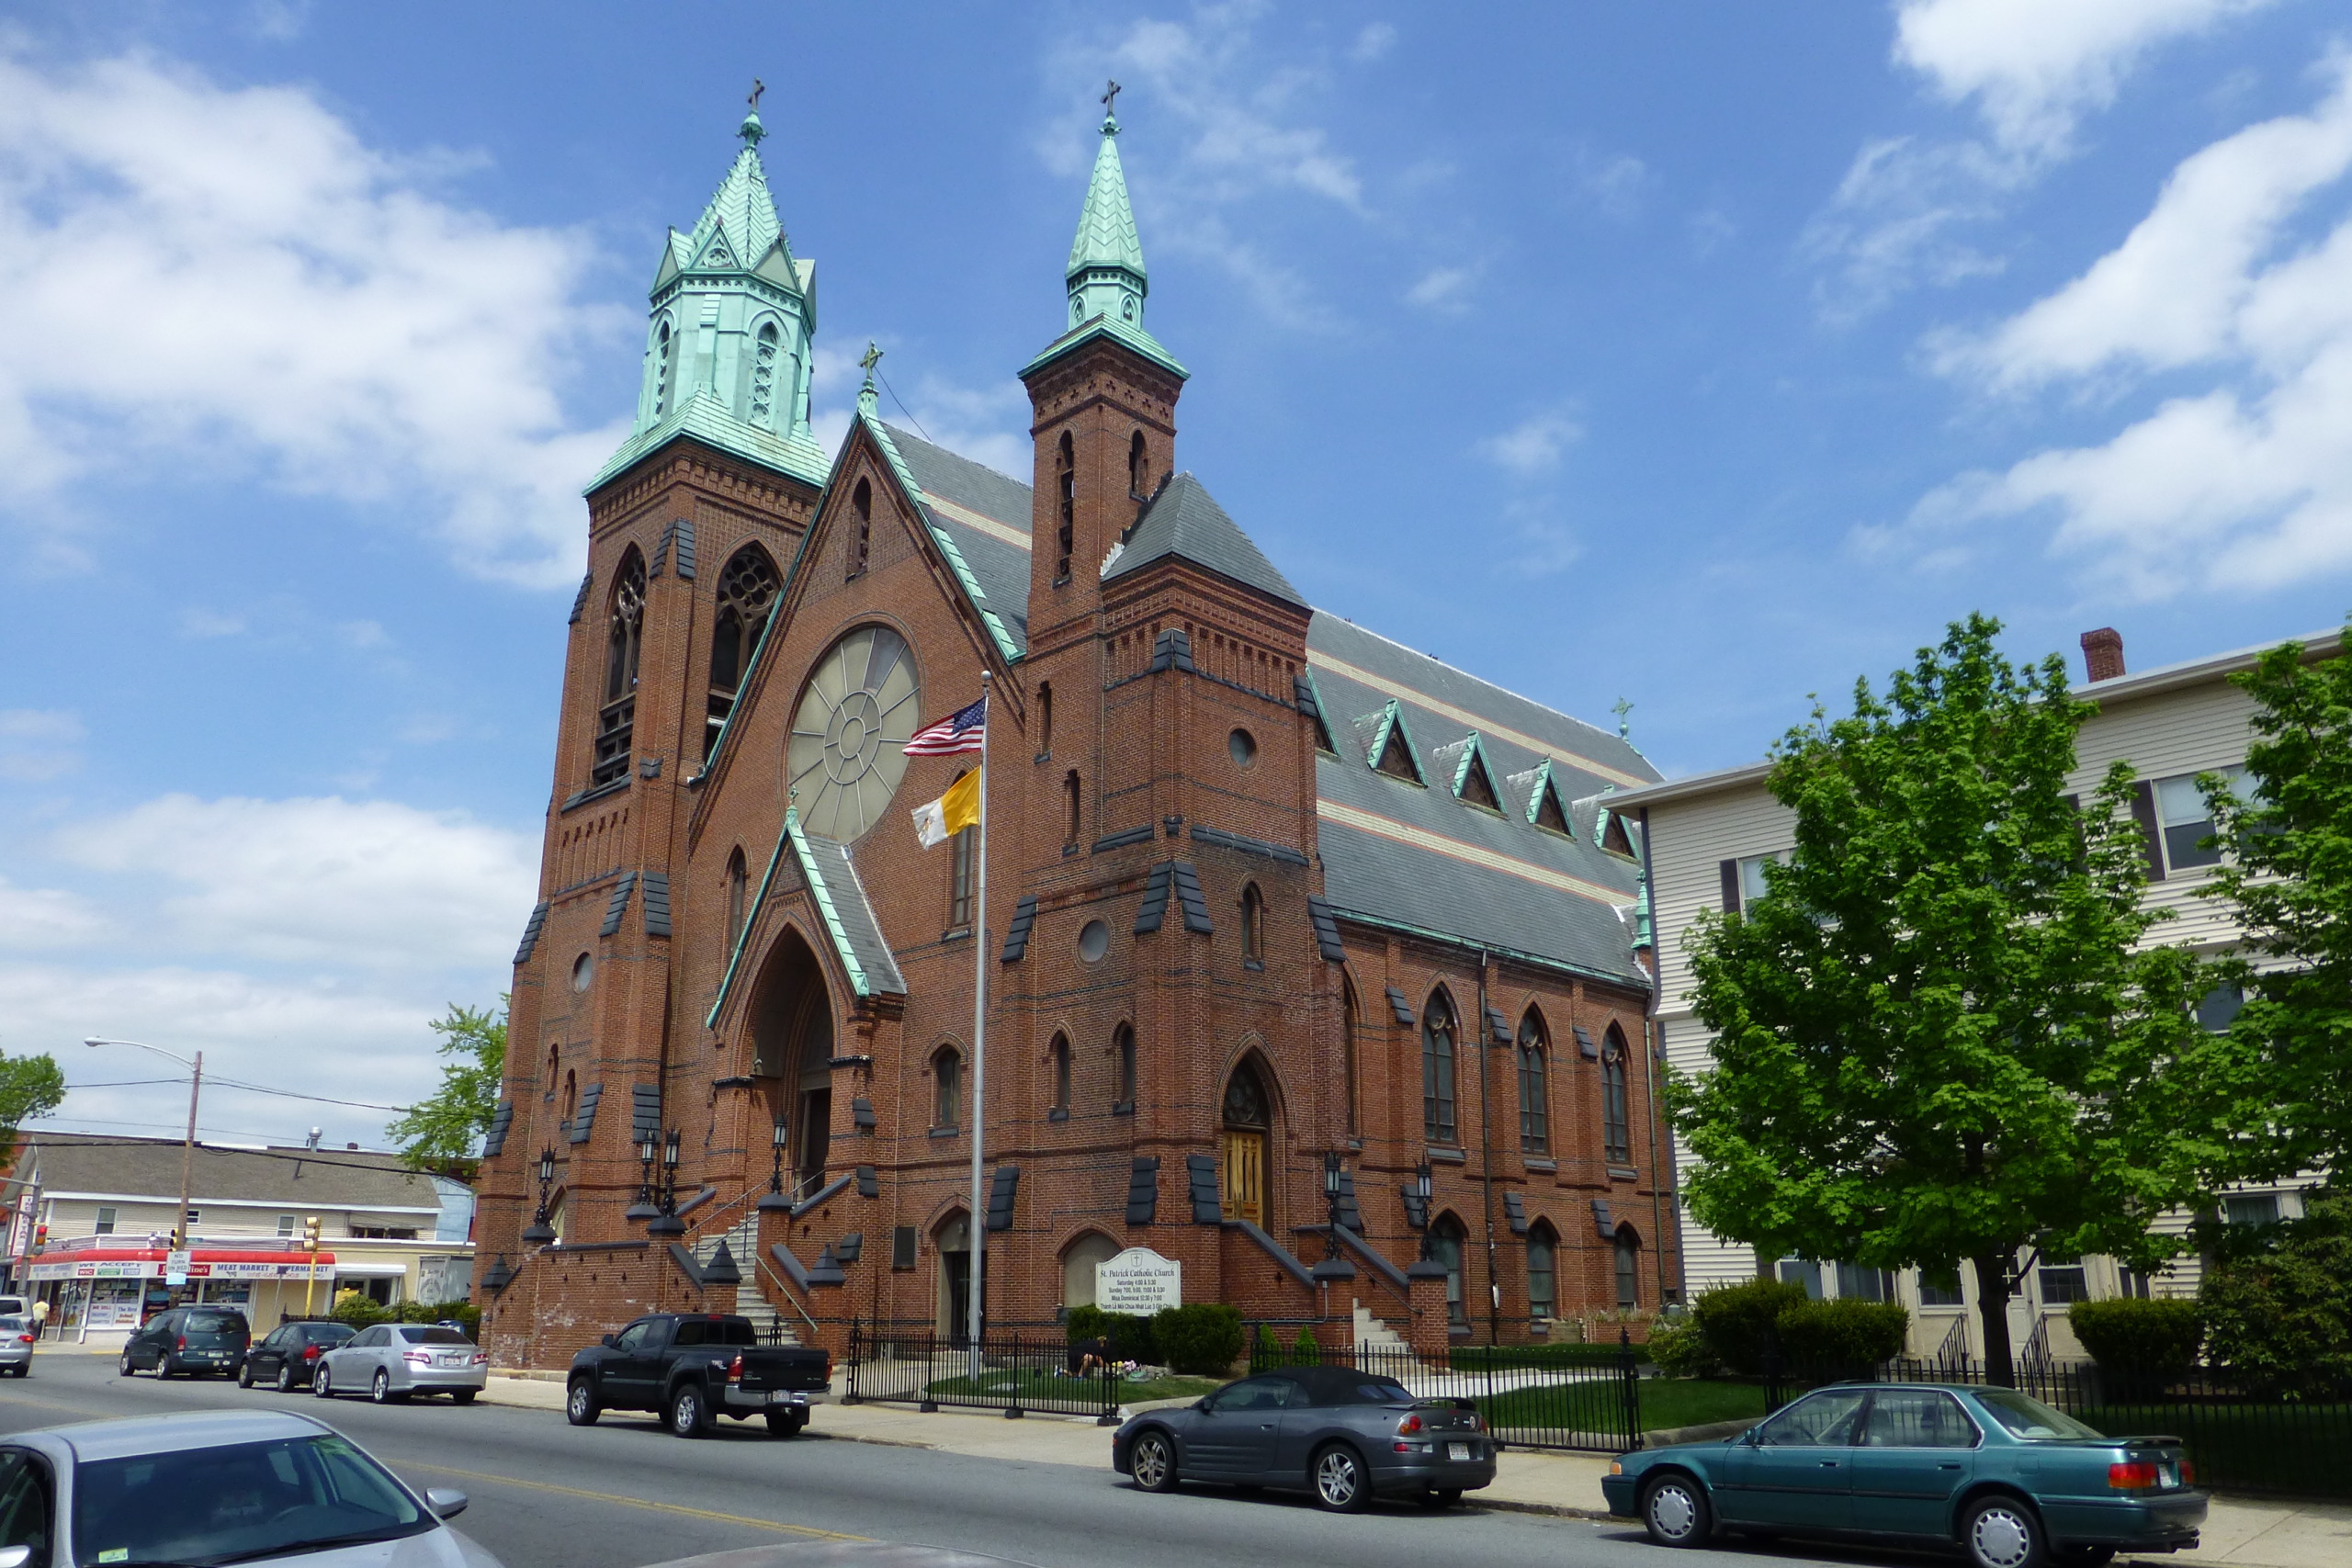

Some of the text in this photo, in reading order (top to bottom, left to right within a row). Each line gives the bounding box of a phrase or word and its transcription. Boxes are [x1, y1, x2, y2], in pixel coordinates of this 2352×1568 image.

[1109, 1269, 1129, 1278] Patrick
[1130, 1268, 1153, 1277] Catholic
[1155, 1268, 1174, 1277] Church
